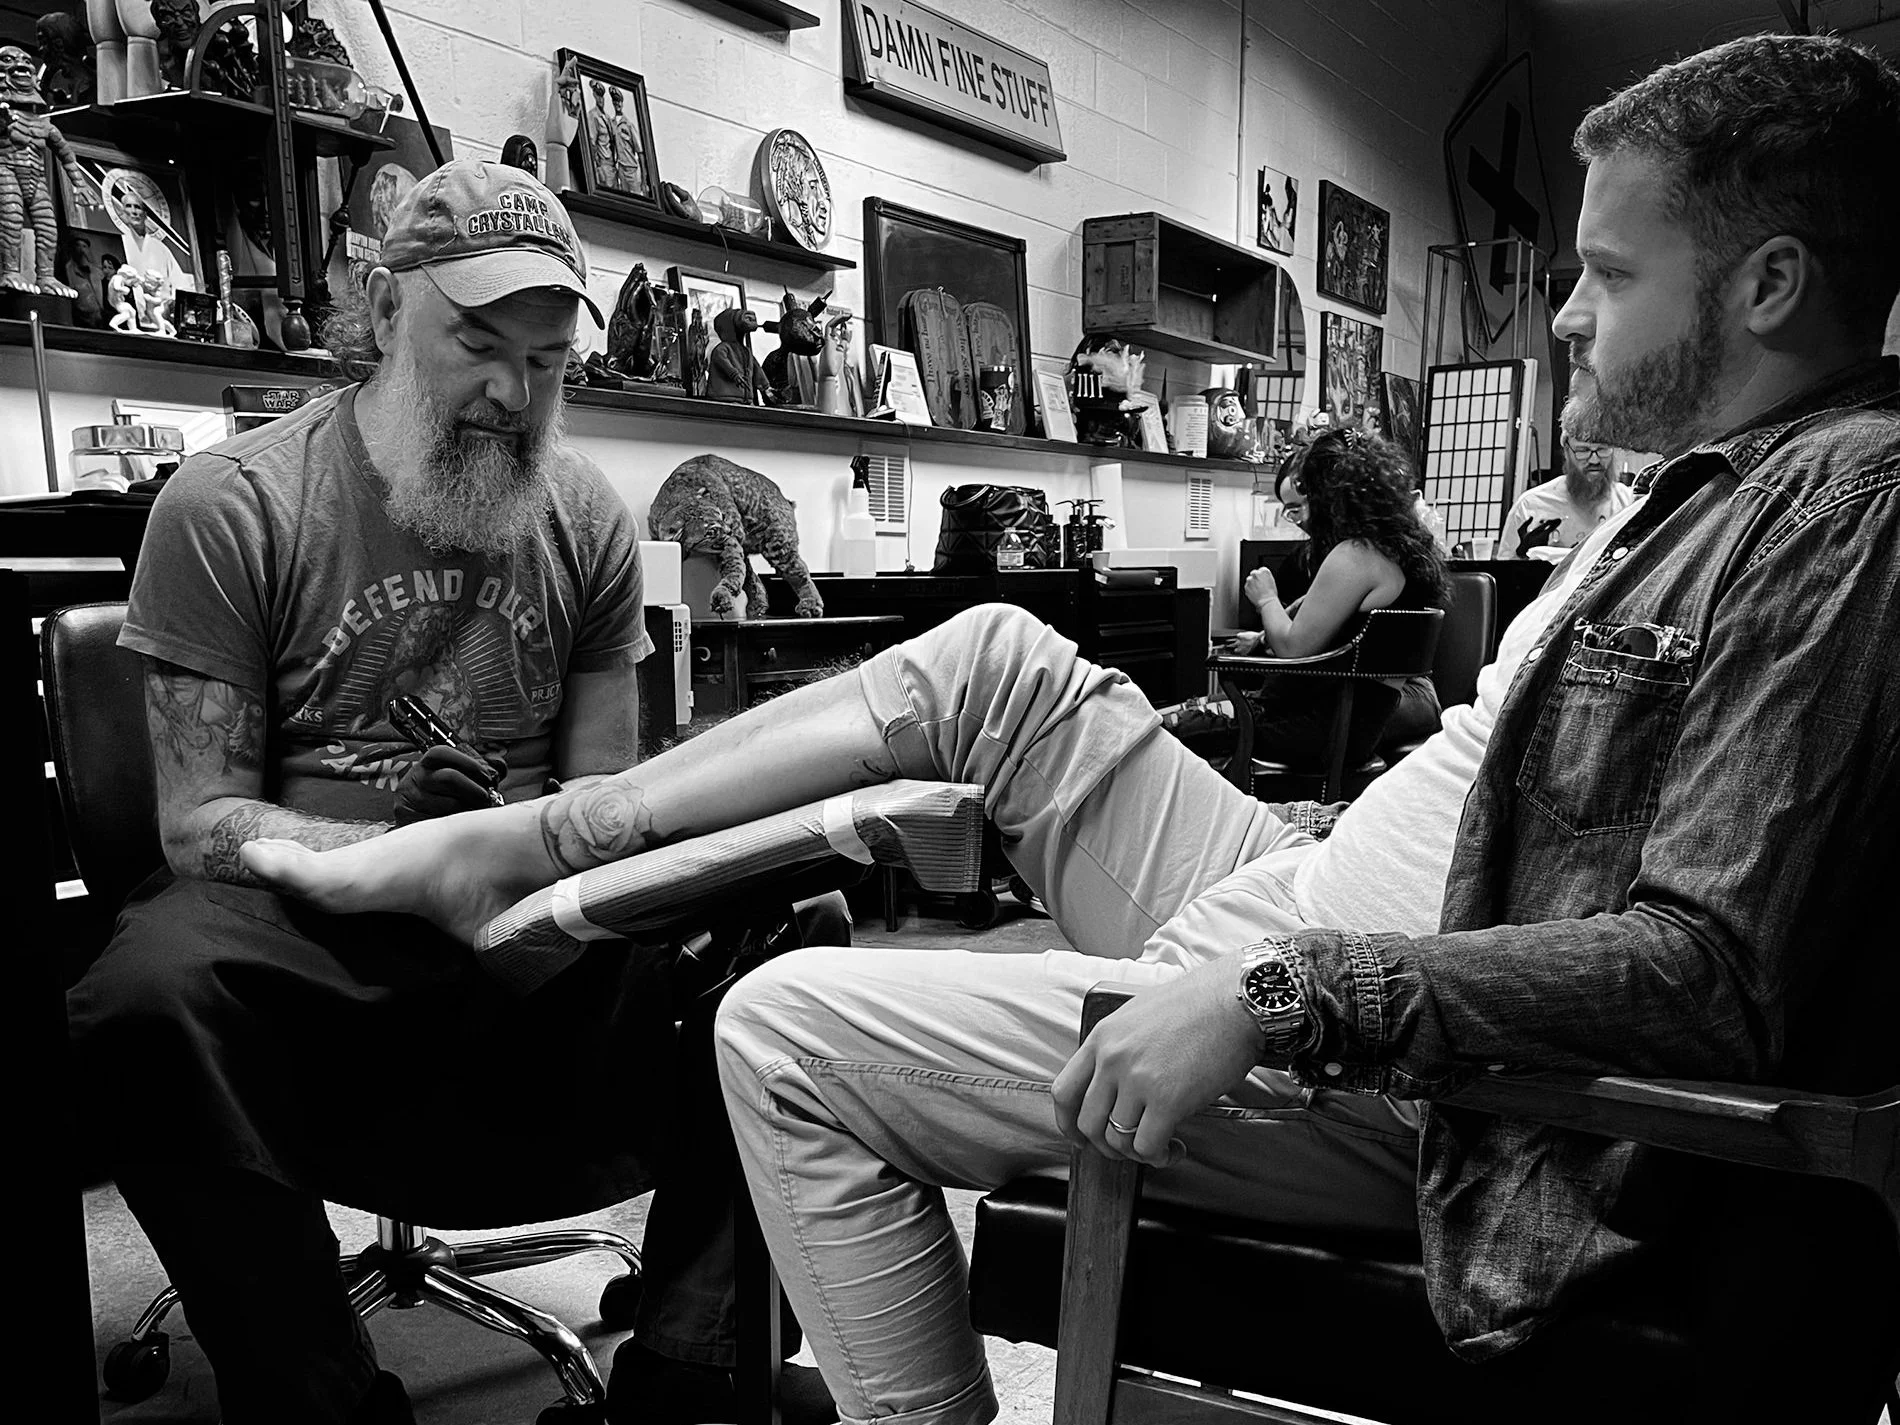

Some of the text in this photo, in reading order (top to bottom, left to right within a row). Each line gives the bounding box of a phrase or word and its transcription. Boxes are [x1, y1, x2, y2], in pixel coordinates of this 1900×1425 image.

[862, 4, 1049, 127] DAMN FINE STUFF
[498, 193, 548, 216] CAMP
[467, 210, 544, 236] CRYSTAL
[262, 389, 300, 400] STAR
[262, 399, 298, 410] WARS
[321, 569, 544, 656] DEFEND OUR
